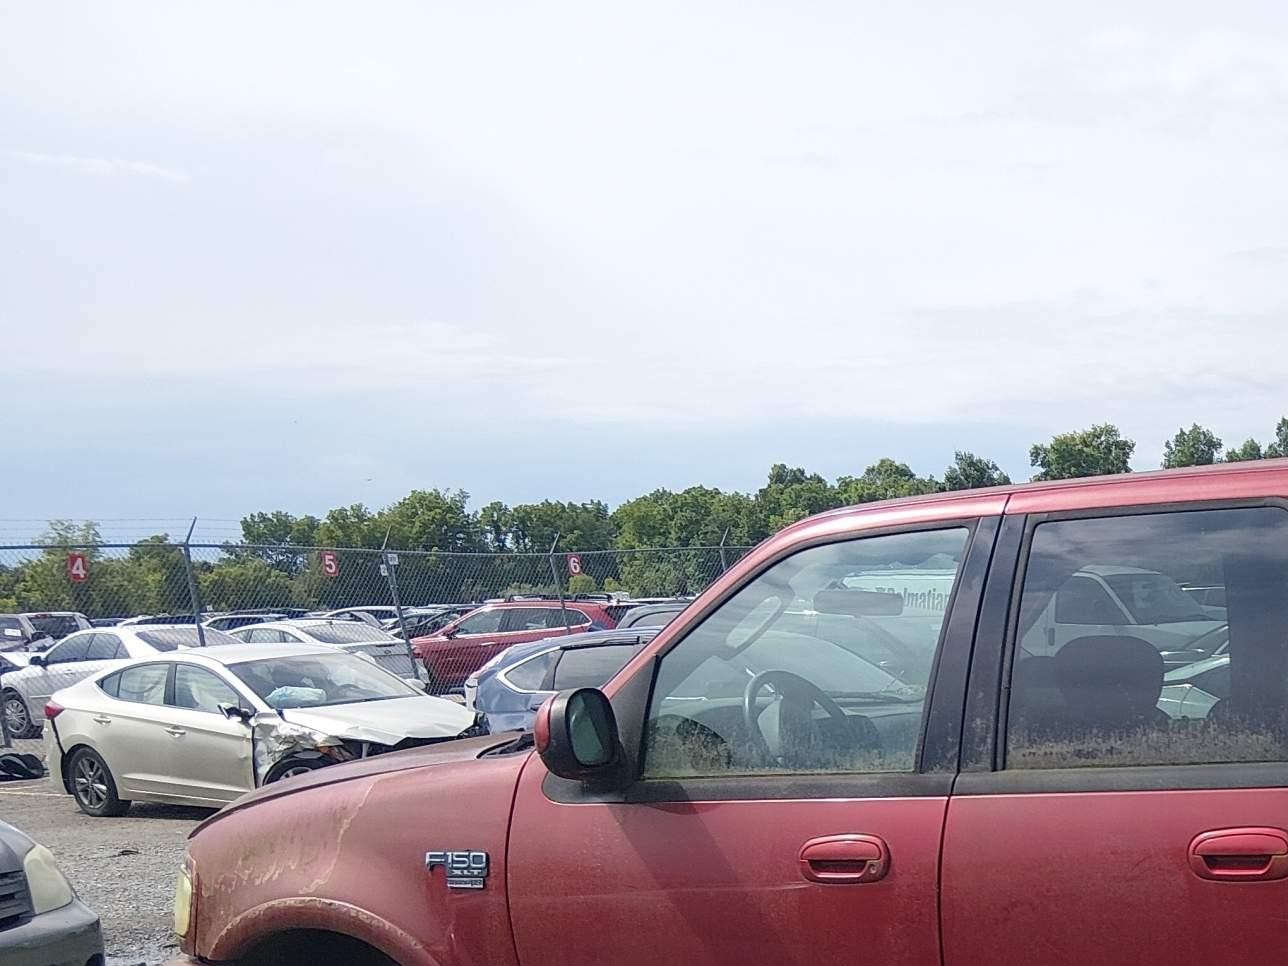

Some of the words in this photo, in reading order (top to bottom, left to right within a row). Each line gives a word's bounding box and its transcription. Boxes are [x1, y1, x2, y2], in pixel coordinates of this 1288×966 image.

[71, 557, 87, 578] 4
[324, 555, 337, 573] 5
[570, 557, 581, 573] 6
